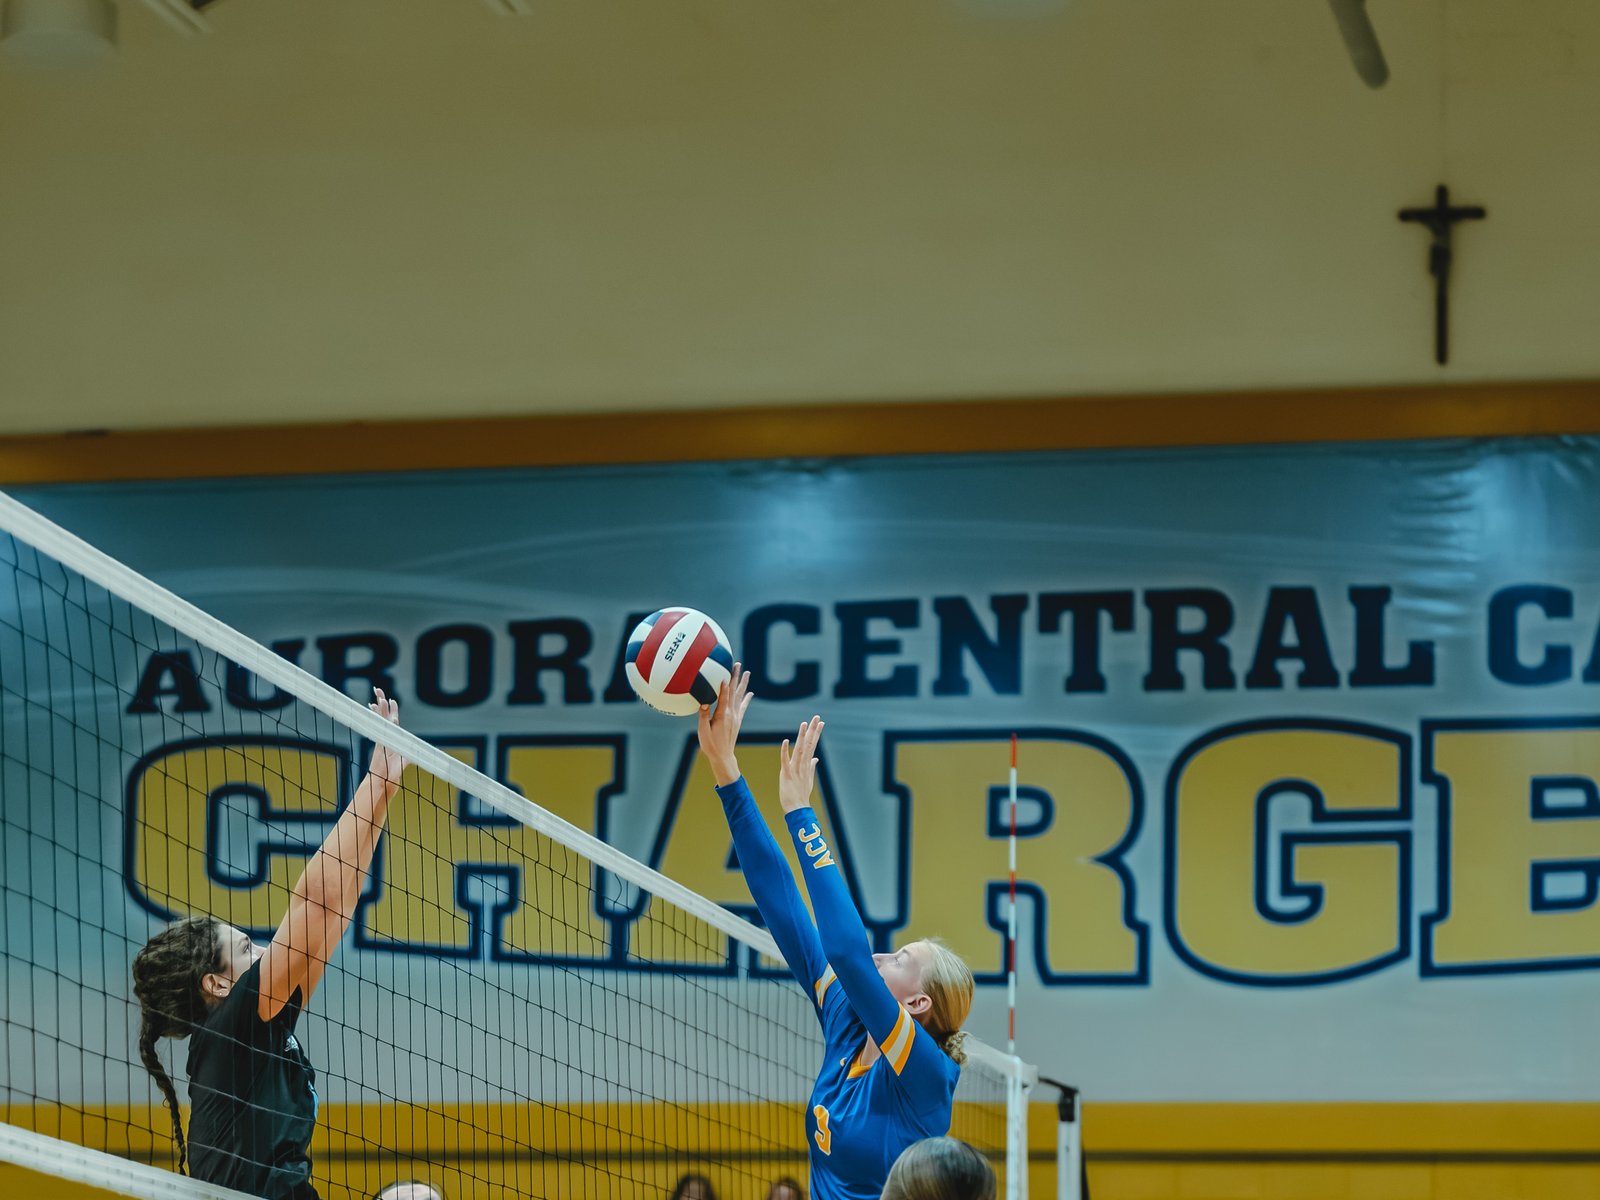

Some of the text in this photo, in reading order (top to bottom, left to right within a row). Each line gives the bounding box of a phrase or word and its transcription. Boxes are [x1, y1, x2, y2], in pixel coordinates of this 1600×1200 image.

[664, 635, 685, 662] NFHS
[742, 584, 1436, 704] CENTRAL
[1488, 584, 1600, 688] C
[798, 823, 835, 870] ACC
